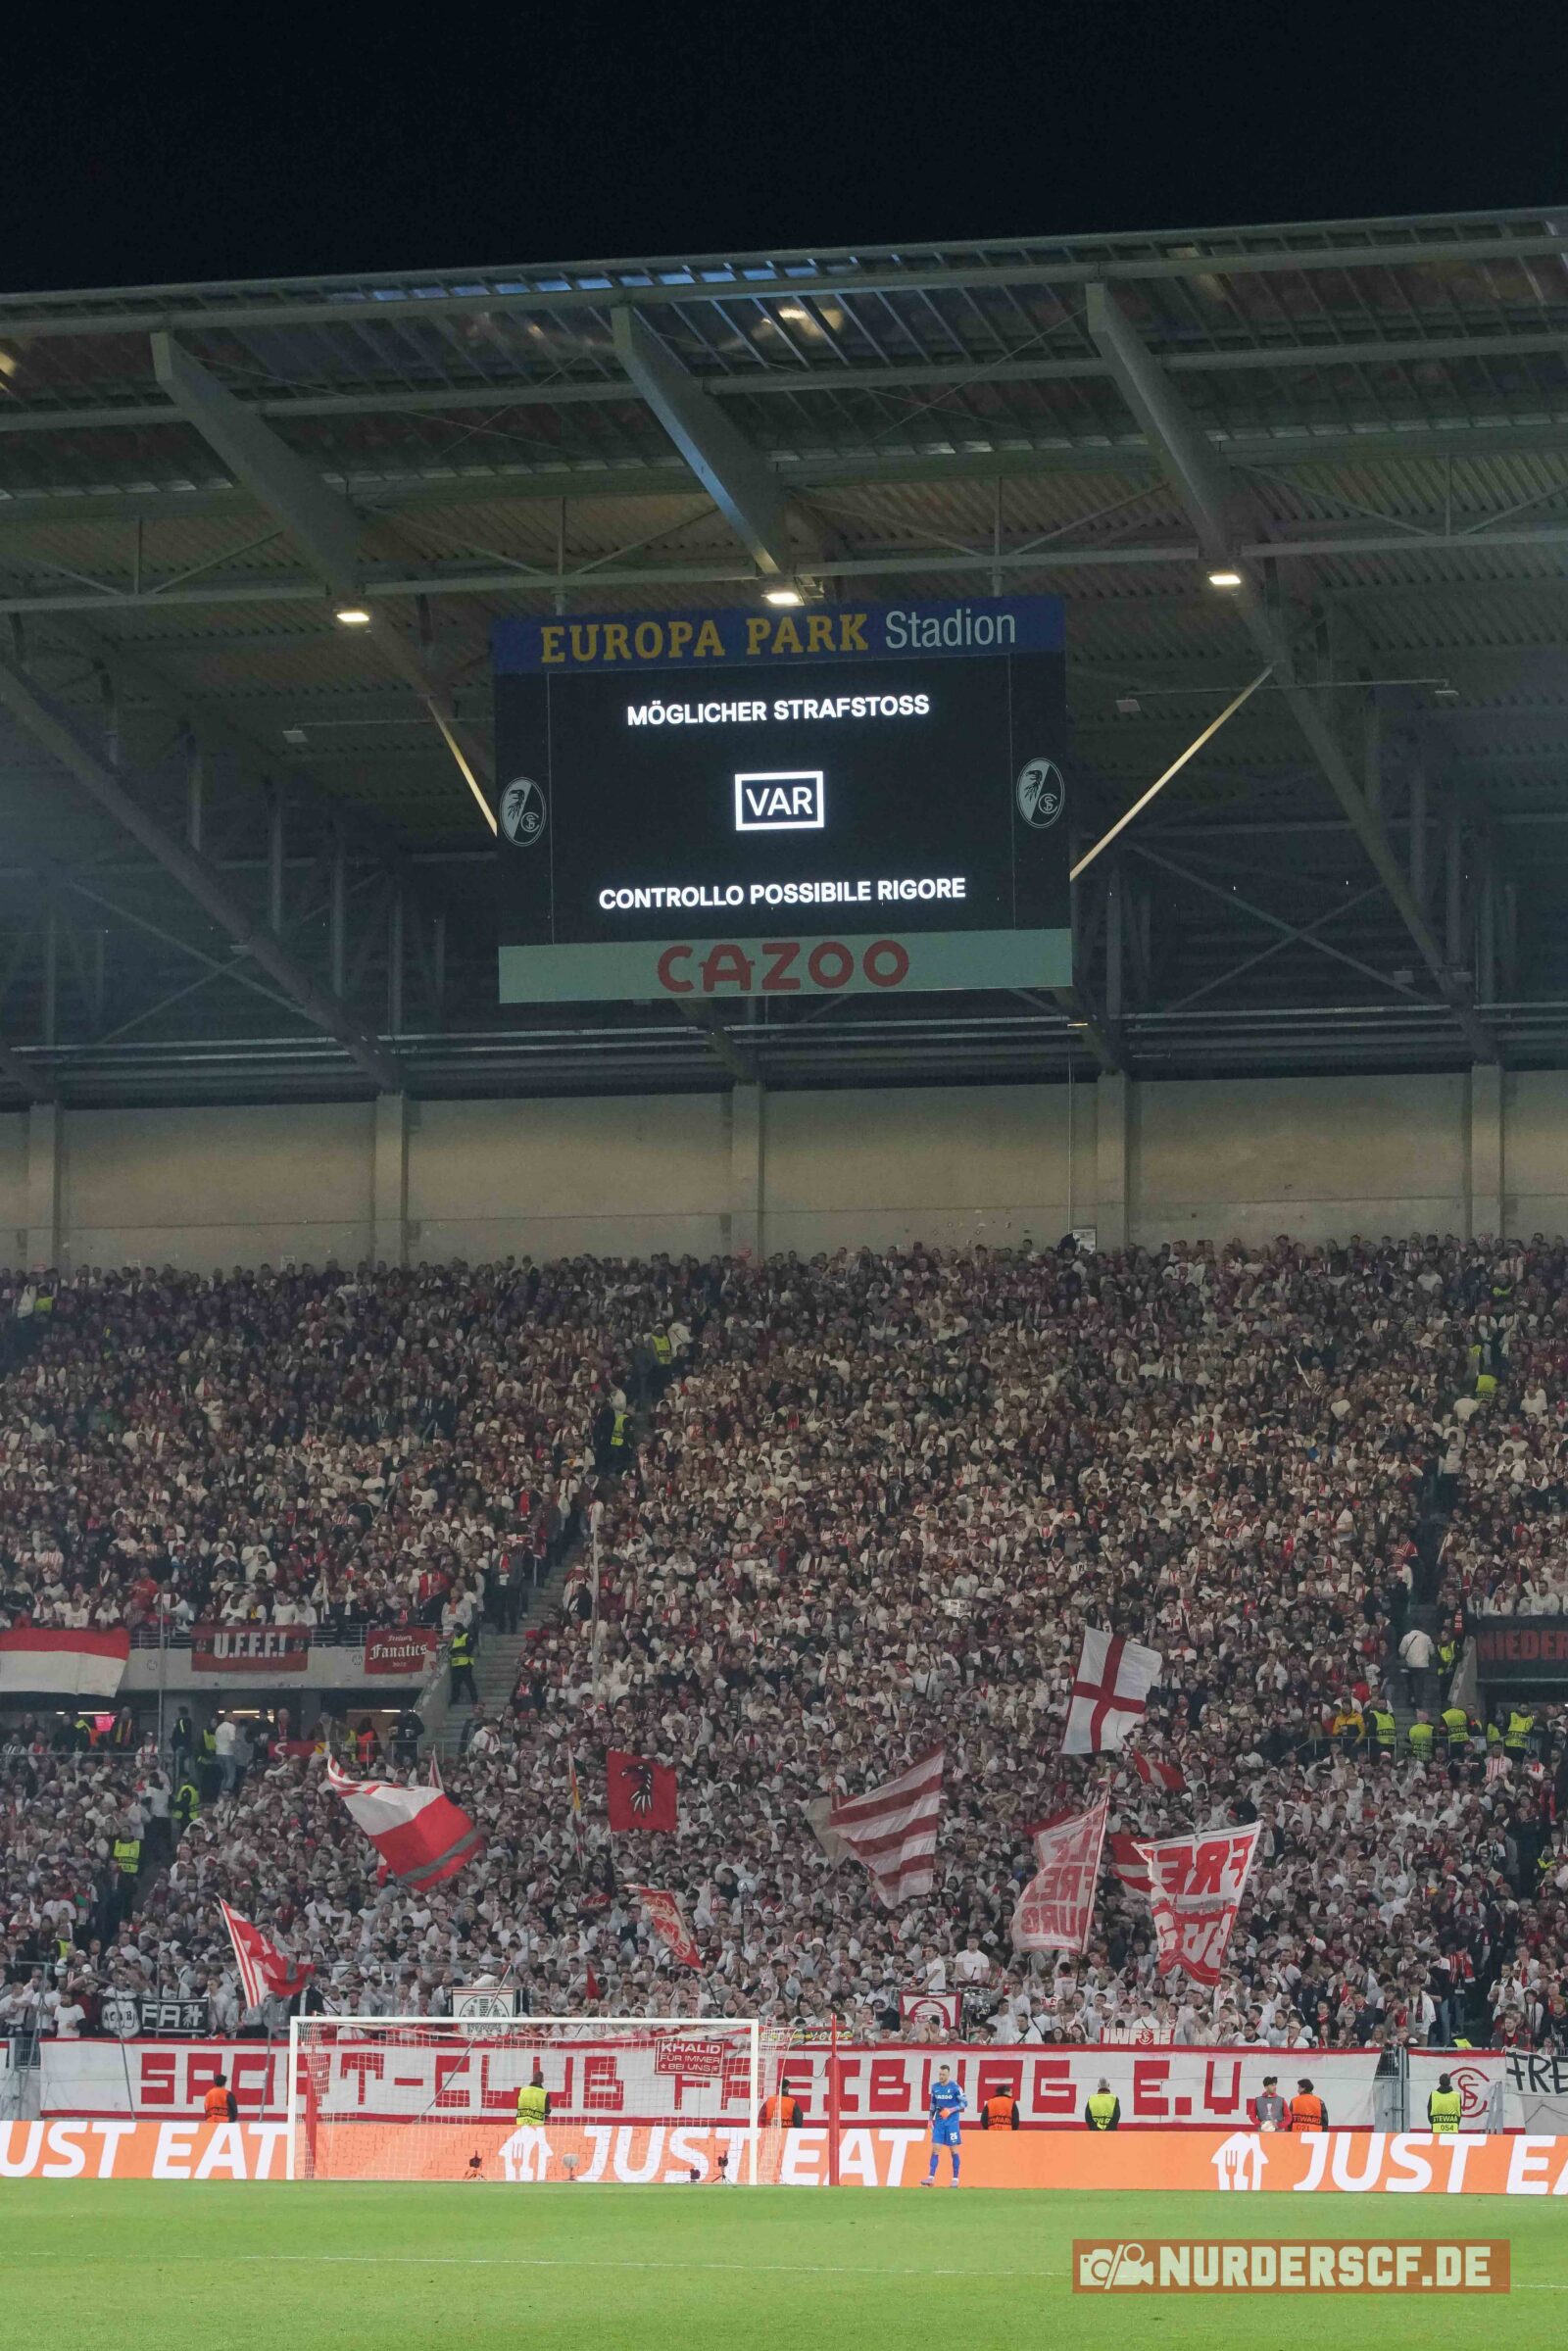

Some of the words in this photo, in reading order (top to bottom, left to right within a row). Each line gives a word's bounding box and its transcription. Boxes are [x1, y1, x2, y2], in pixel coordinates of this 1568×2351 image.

[540, 619, 725, 663] EUROPA
[746, 613, 868, 655] PARK
[886, 609, 1015, 649] Stadion
[627, 700, 766, 725] MÖGLICHER
[774, 695, 929, 720] STRAFSTOSS
[746, 786, 812, 816] VAR
[599, 885, 744, 909] CONTROLLO
[751, 881, 870, 905] POSSIBILE
[878, 878, 965, 900] RIGORE
[658, 939, 909, 993] CAZOO
[368, 1642, 428, 1660] Fanatics
[662, 2042, 721, 2054] KHALID
[685, 2055, 720, 2064] IMMER
[152, 2122, 291, 2180] EAT
[575, 2126, 760, 2183] JUST
[783, 2128, 925, 2187] EAT
[1294, 2132, 1487, 2192] JUST
